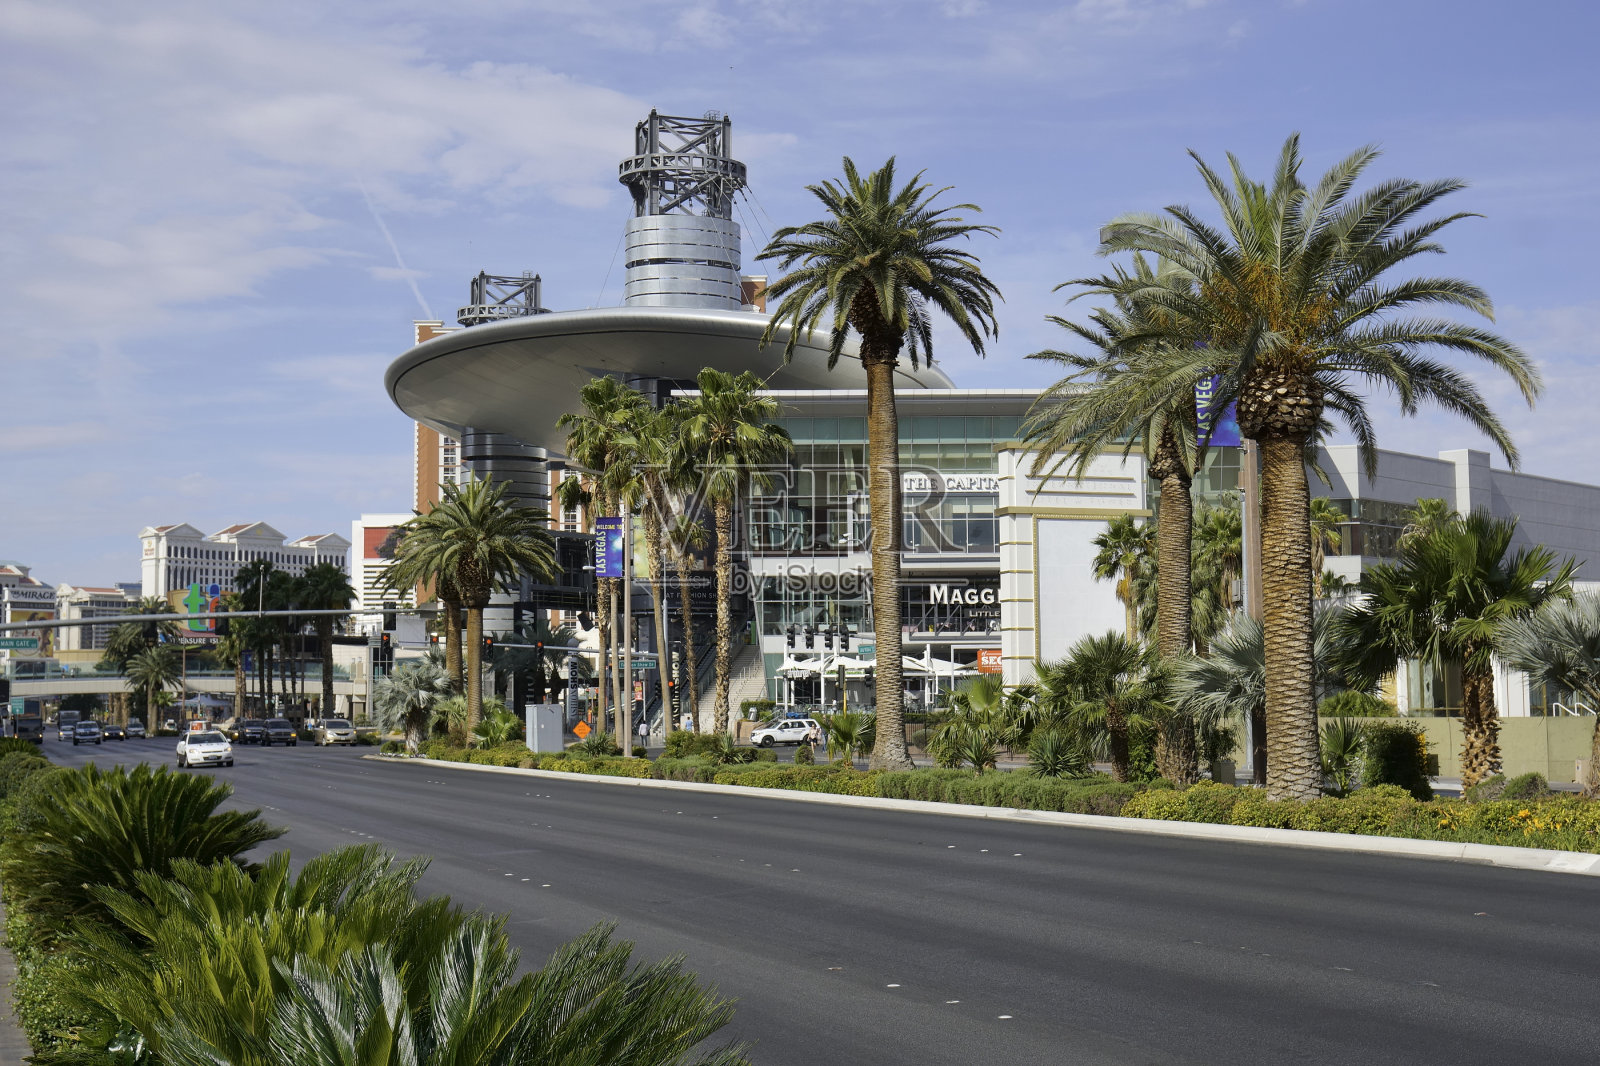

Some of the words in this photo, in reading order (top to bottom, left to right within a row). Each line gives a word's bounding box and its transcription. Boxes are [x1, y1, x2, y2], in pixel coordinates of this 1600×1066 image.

[1196, 376, 1213, 409] VEG
[905, 477, 938, 490] THE
[596, 530, 606, 558] VEGAS
[596, 558, 606, 573] LAS
[20, 590, 56, 600] MIRAGE
[969, 609, 1000, 618] LITTLE
